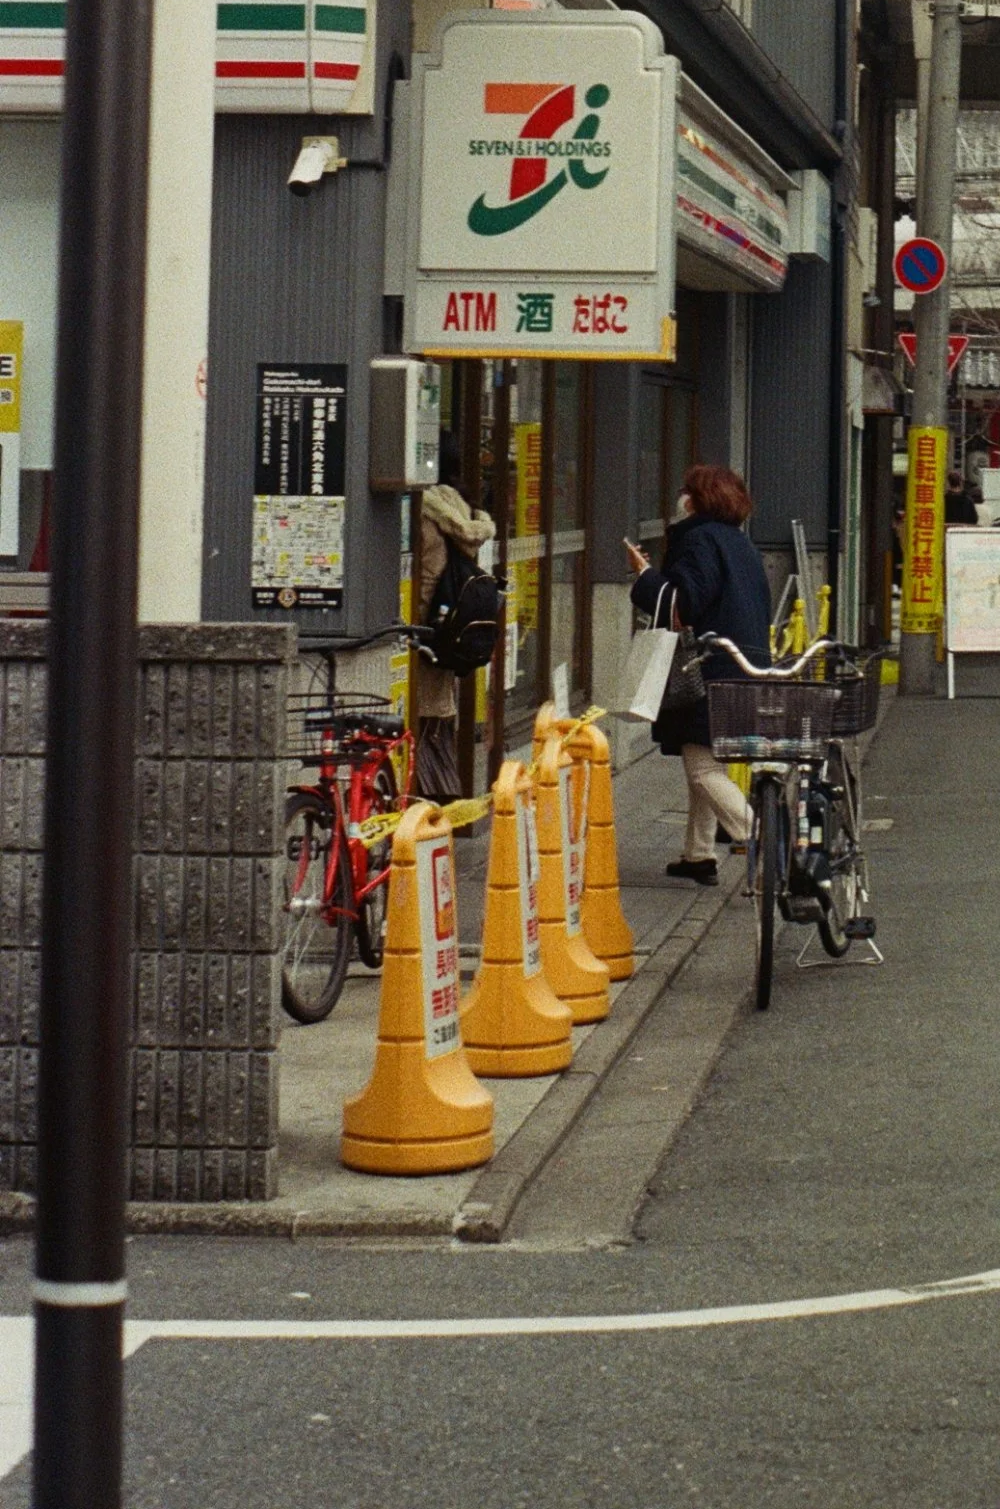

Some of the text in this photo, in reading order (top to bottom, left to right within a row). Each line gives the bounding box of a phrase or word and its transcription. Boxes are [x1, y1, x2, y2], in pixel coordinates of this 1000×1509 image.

[469, 140, 514, 156] SEVEN
[516, 141, 525, 156] &
[536, 141, 612, 157] HOLDINGS
[443, 292, 629, 334] ATM 酒 たばこ
[911, 435, 937, 605] 自転車通行禁止
